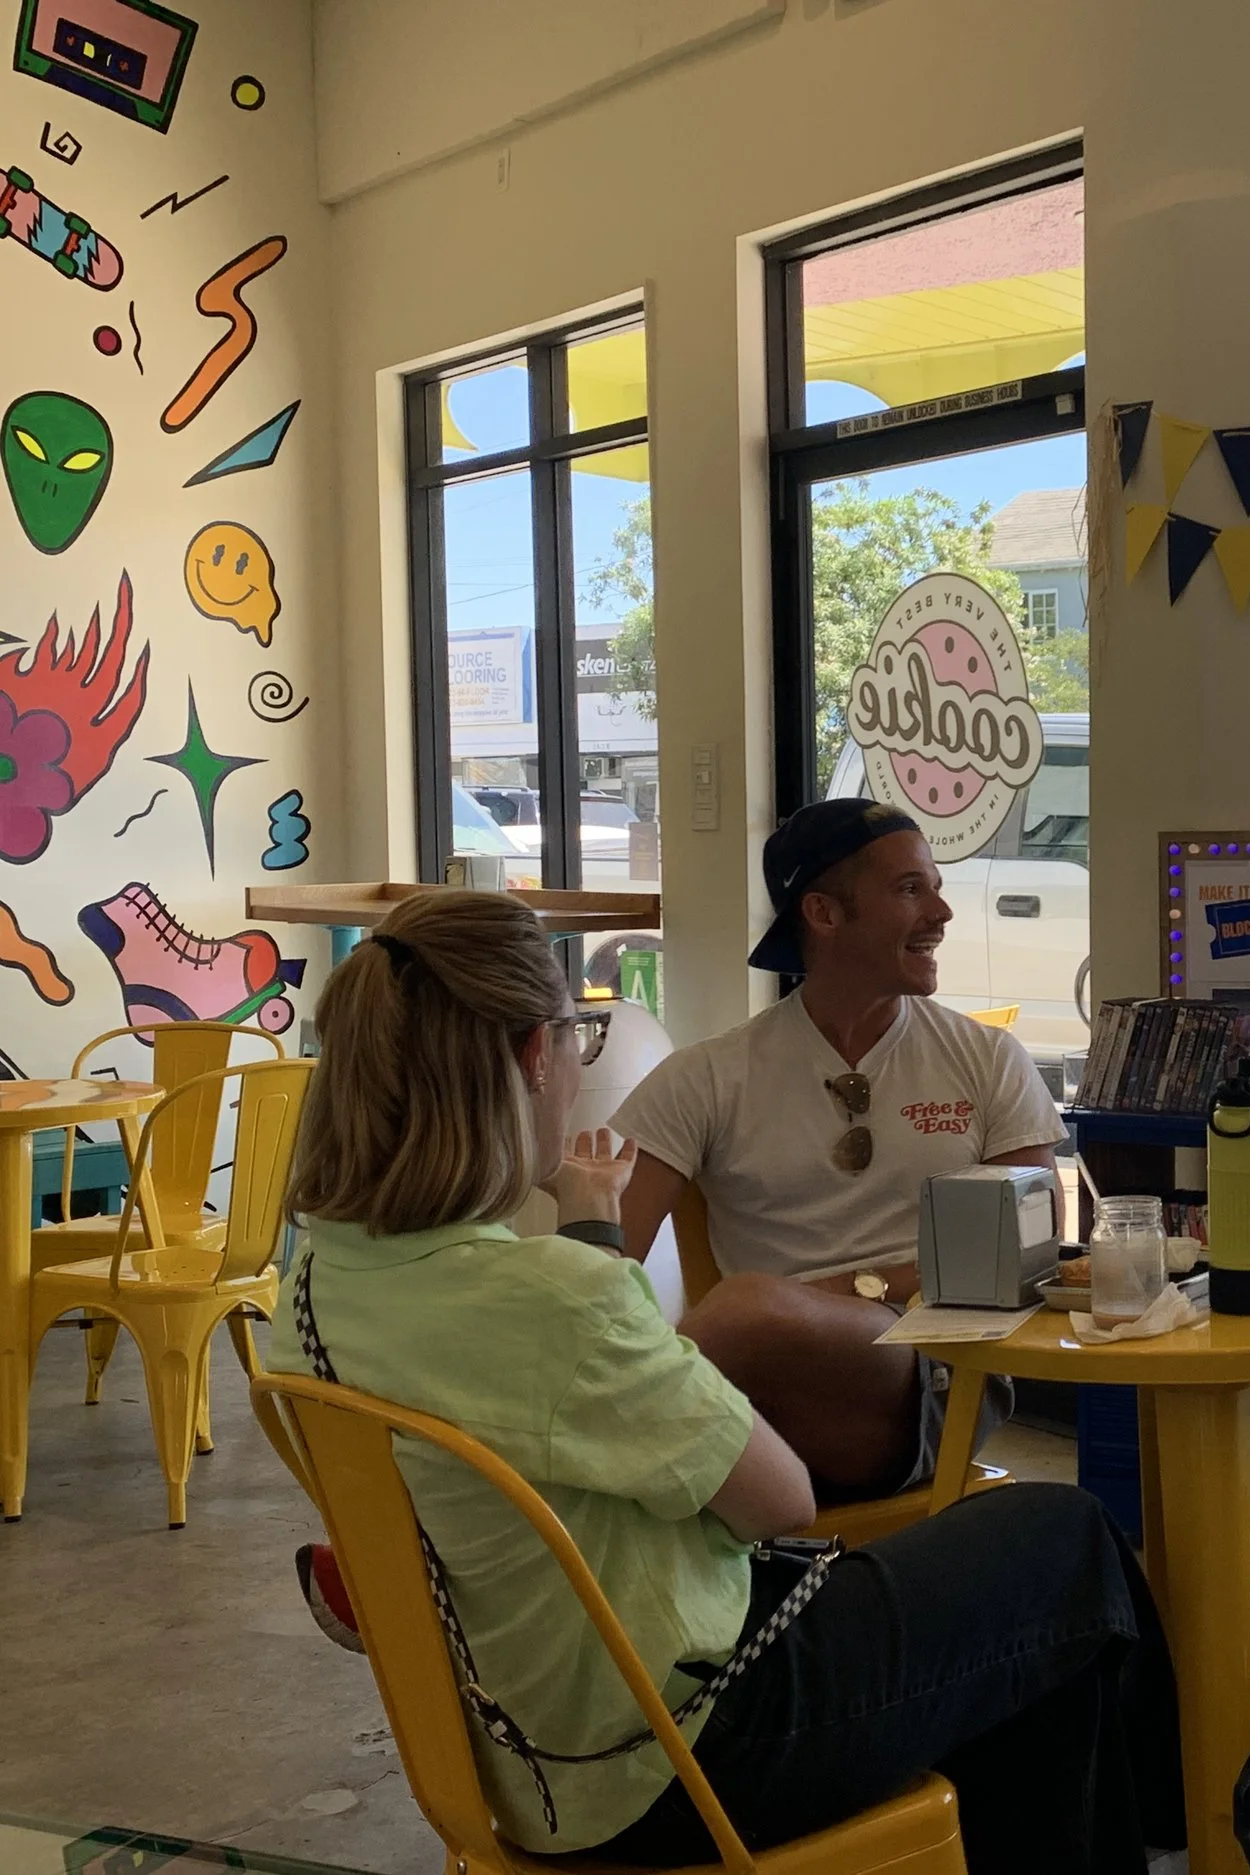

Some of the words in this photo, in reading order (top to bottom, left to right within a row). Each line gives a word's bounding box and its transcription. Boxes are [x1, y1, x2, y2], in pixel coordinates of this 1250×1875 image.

[871, 415, 879, 428] TO
[906, 402, 937, 421] UNLOCKED
[940, 396, 962, 413] DURING
[964, 390, 994, 408] BUSINESS
[996, 383, 1019, 401] HOURS
[1199, 884, 1234, 901] MAKE
[1239, 884, 1250, 900] IT
[900, 1101, 952, 1121] Free
[954, 1099, 974, 1117] &
[914, 1118, 972, 1135] Easy
